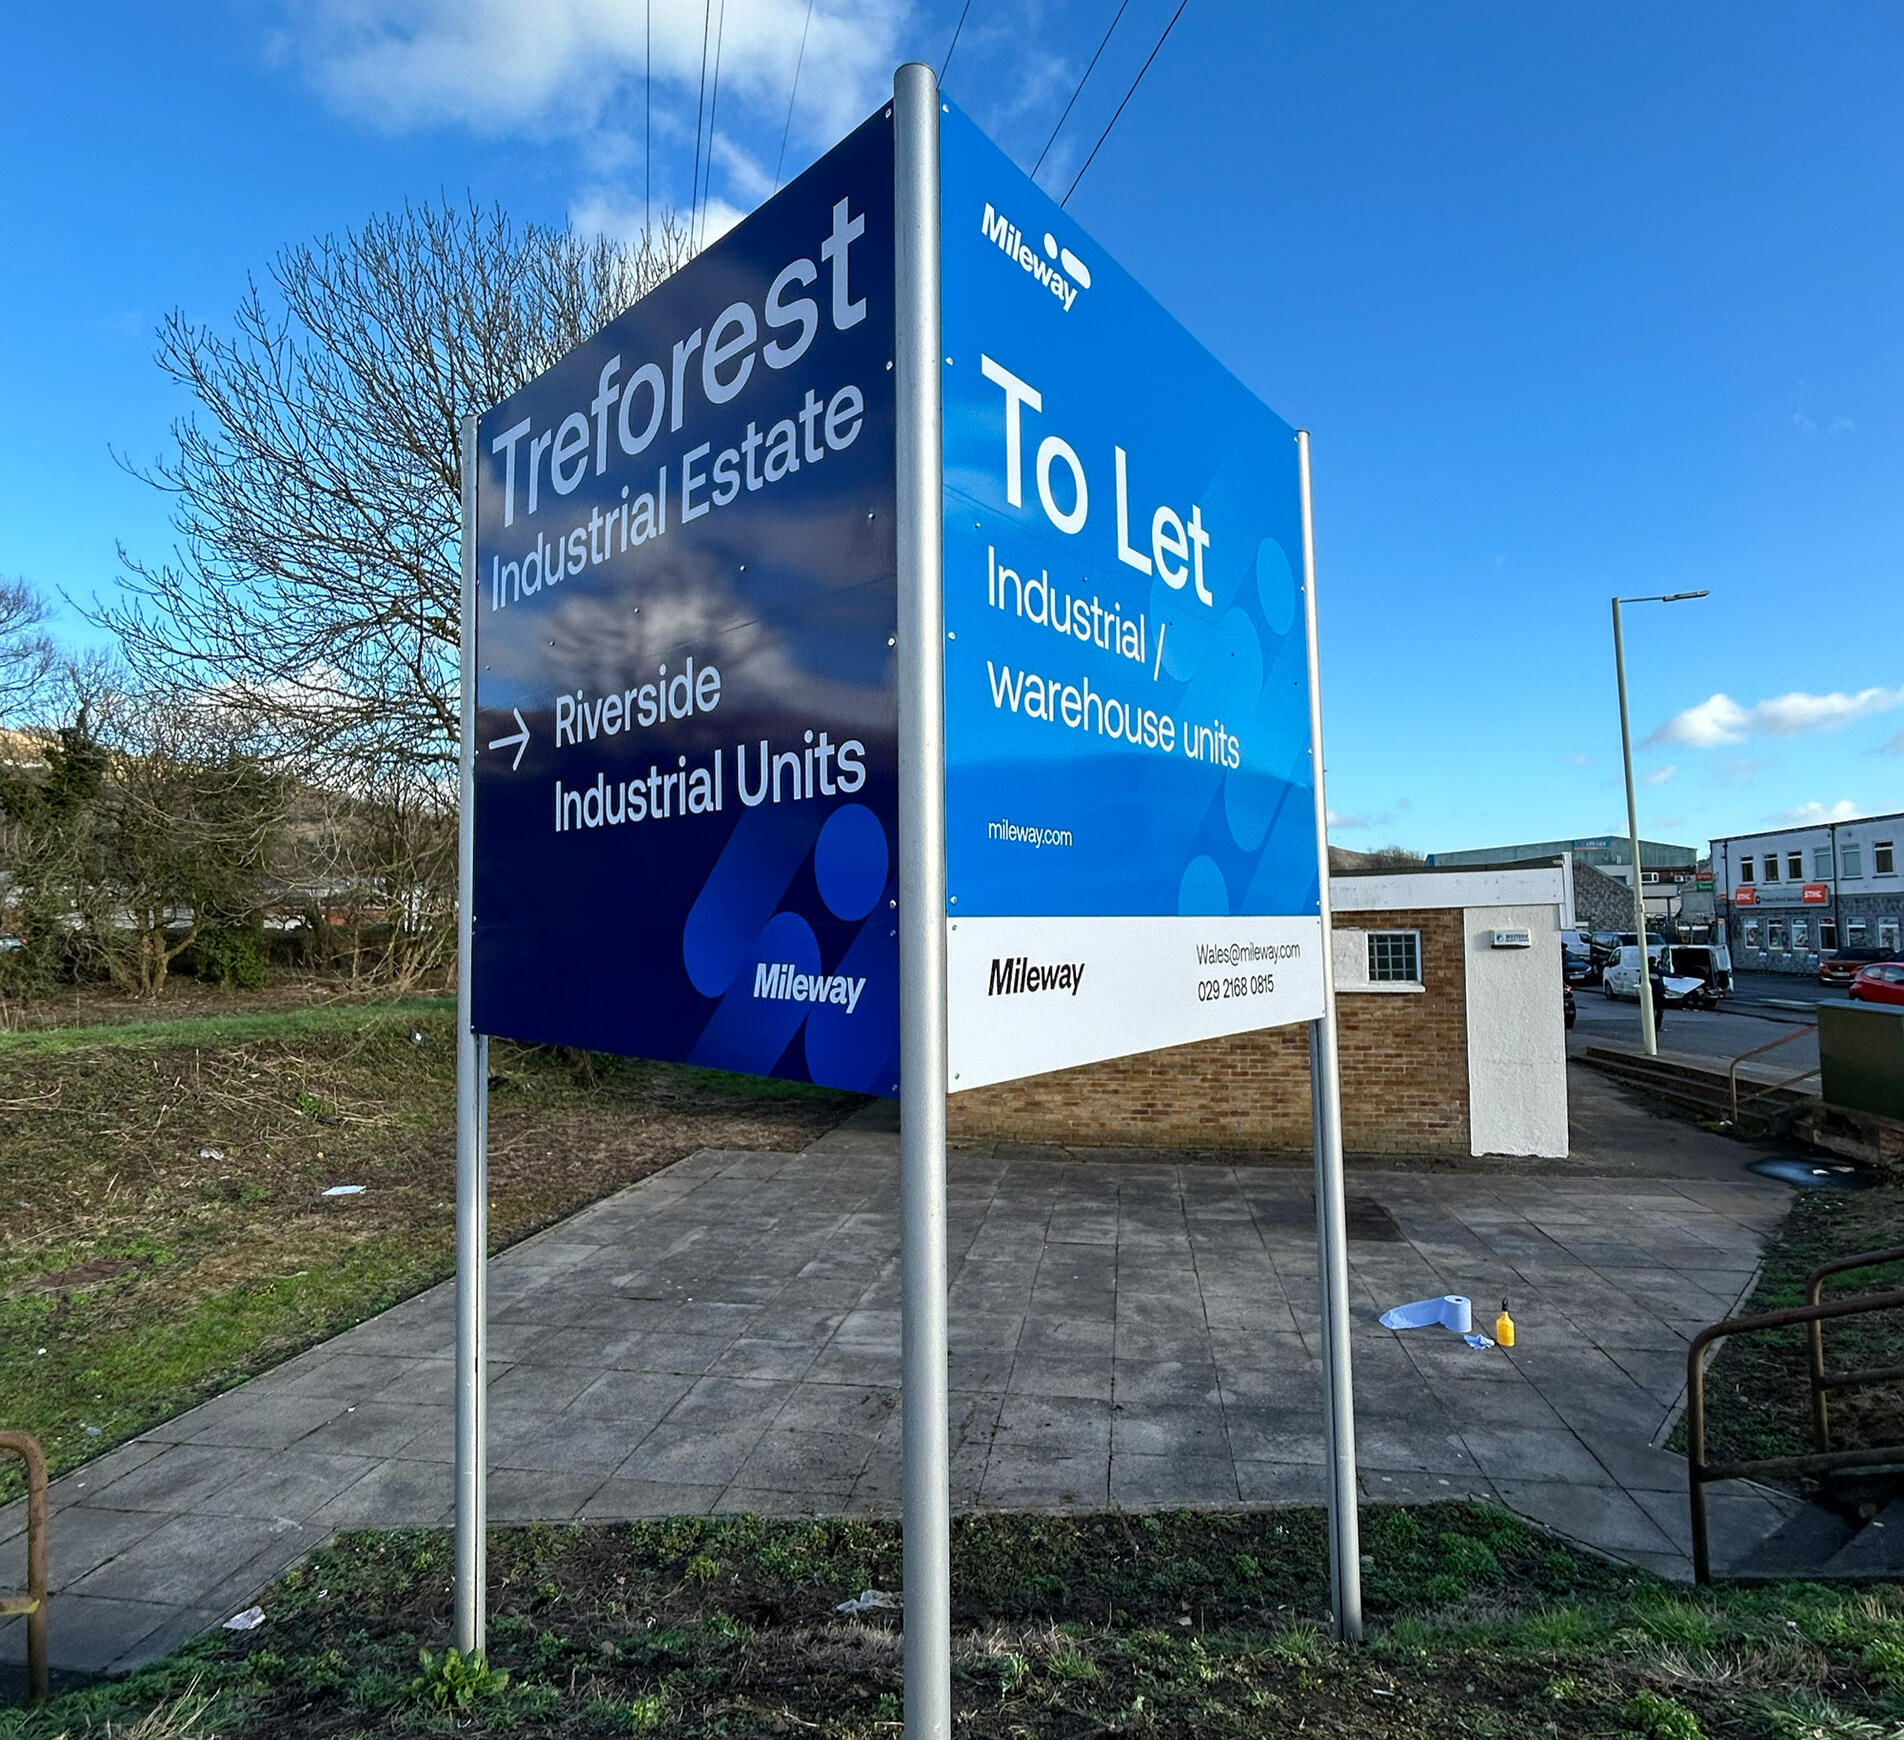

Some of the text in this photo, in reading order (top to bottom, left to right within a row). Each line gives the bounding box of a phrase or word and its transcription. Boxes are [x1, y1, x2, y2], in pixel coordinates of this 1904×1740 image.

[981, 202, 1078, 312] Mileway
[492, 196, 867, 528] Treforest
[492, 385, 865, 612] Industrial Estate
[981, 353, 1213, 607] To Let
[988, 545, 1146, 663] Industrial
[555, 656, 722, 748] Riverside
[986, 659, 1241, 770] warehouse units
[554, 729, 867, 833] Industrial Units
[987, 818, 1074, 849] mileway.com
[752, 962, 867, 1014] Mileway
[987, 957, 1086, 997] Mileway
[1196, 942, 1301, 967] Wales@mileway.com
[1197, 973, 1275, 1002] 029 2168 0815
